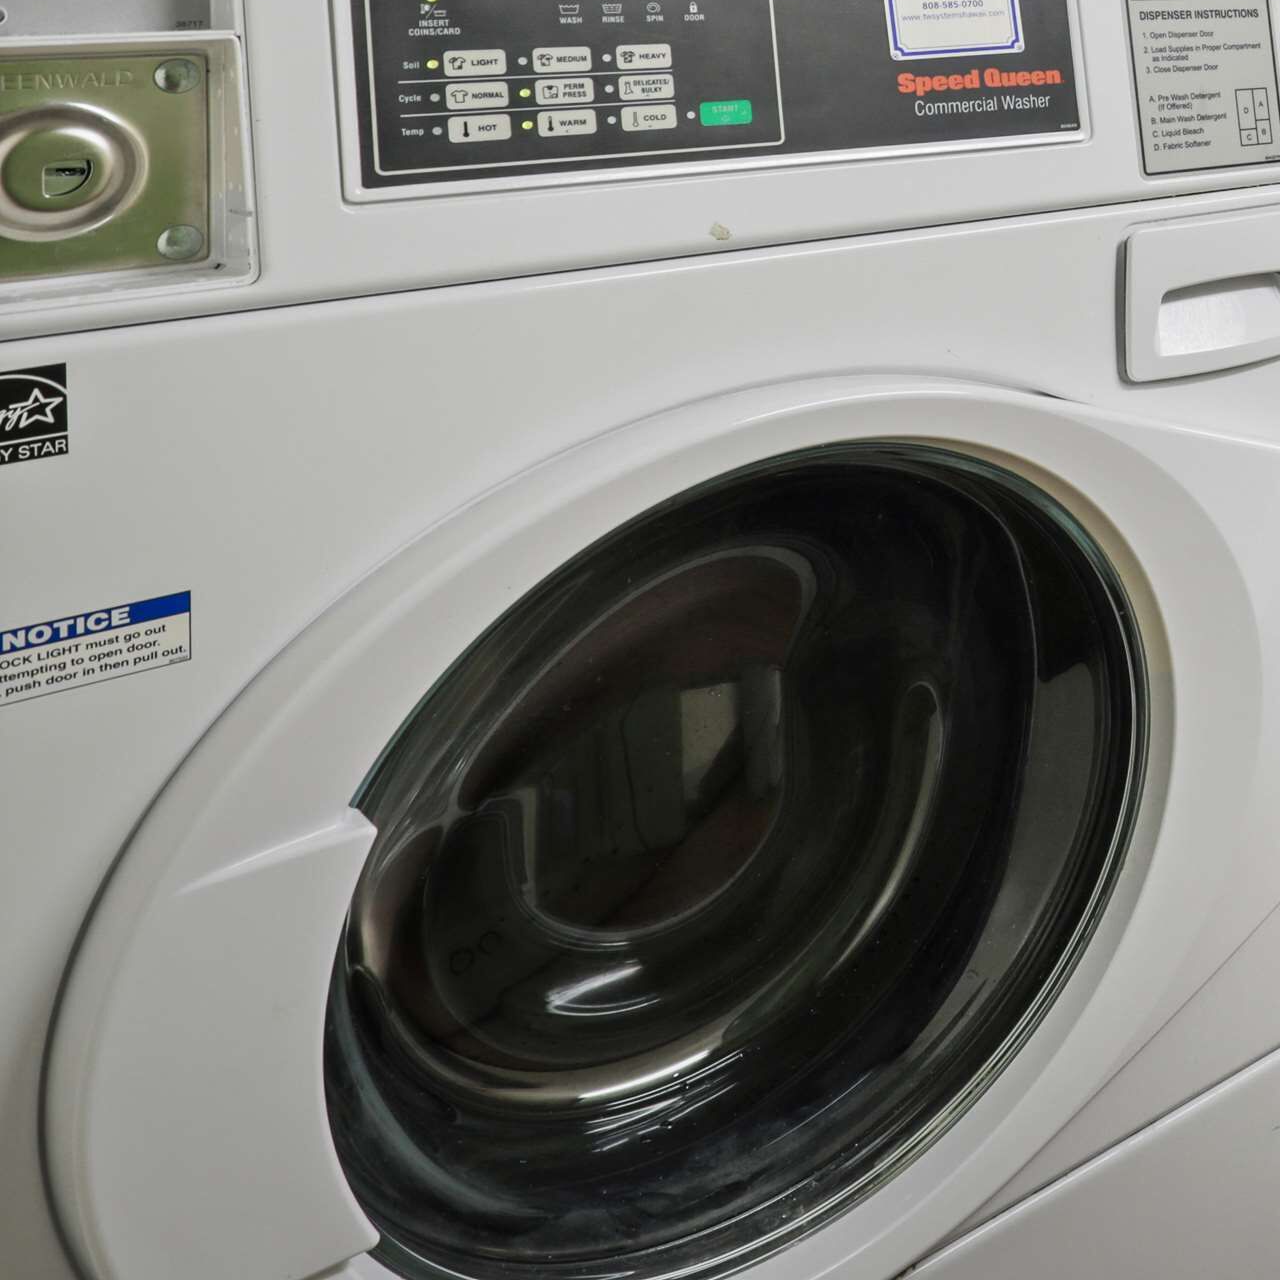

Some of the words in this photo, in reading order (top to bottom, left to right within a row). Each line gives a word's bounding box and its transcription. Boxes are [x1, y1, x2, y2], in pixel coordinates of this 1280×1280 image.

[922, 0, 984, 10] 808-585-0700
[559, 16, 583, 24] WASH
[602, 15, 625, 23] RINSE
[646, 14, 664, 22] SPIN
[684, 13, 705, 21] DOOR
[1140, 10, 1193, 21] DISPENSER
[1194, 8, 1260, 19] INSTRUCTIONS
[418, 19, 450, 28] INSERT
[408, 27, 461, 36] COINS/CARD
[1150, 31, 1167, 40] Open
[1168, 30, 1198, 39] Dispenser
[1199, 30, 1214, 38] Door
[1151, 45, 1167, 53] Load
[1168, 44, 1194, 54] Supplies
[1202, 44, 1221, 52] Proper
[1222, 42, 1261, 51] Compartment
[402, 61, 420, 70] Soil
[471, 58, 498, 66] LIGHT
[556, 55, 587, 63] MEDIUM
[639, 52, 667, 60] HEAVY
[1161, 54, 1189, 62] Indicated
[1153, 65, 1171, 74] Close
[1172, 64, 1202, 73] Dispenser
[1203, 63, 1218, 71] Door
[896, 69, 981, 96] Speed
[983, 67, 1062, 88] Queen
[562, 90, 587, 99] PRESS
[641, 86, 663, 94] BULKY
[398, 94, 422, 104] Cycle
[471, 91, 505, 100] NORMAL
[1158, 94, 1170, 102] Pre
[1171, 93, 1189, 101] Wash
[1191, 91, 1221, 101] Detergent
[914, 96, 998, 117] Commercial
[1001, 93, 1051, 111] Washer
[1166, 101, 1193, 111] Offered)
[1160, 116, 1176, 124] Main
[1177, 114, 1195, 123] Wash
[1196, 112, 1227, 122] Detergent
[401, 127, 424, 137] Temp
[478, 124, 497, 132] HOT
[559, 119, 587, 127] WARM
[643, 113, 667, 122] COLD
[1161, 129, 1181, 139] Liquid
[1182, 127, 1204, 136] Bleach
[1163, 141, 1183, 150] Fabric
[1185, 140, 1211, 149] Softener
[18, 438, 67, 459] STAR
[1, 606, 131, 652] NOTICE
[37, 643, 82, 662] LIGHT
[85, 635, 120, 651] must
[123, 630, 141, 643] go
[144, 624, 167, 636] out
[71, 655, 85, 667] to
[88, 648, 123, 663] open
[126, 638, 161, 654] door.
[5, 678, 42, 697] push
[45, 669, 79, 686] door
[82, 666, 96, 677] in
[99, 657, 130, 673] then
[133, 649, 158, 666] pull
[161, 644, 187, 658] out.
